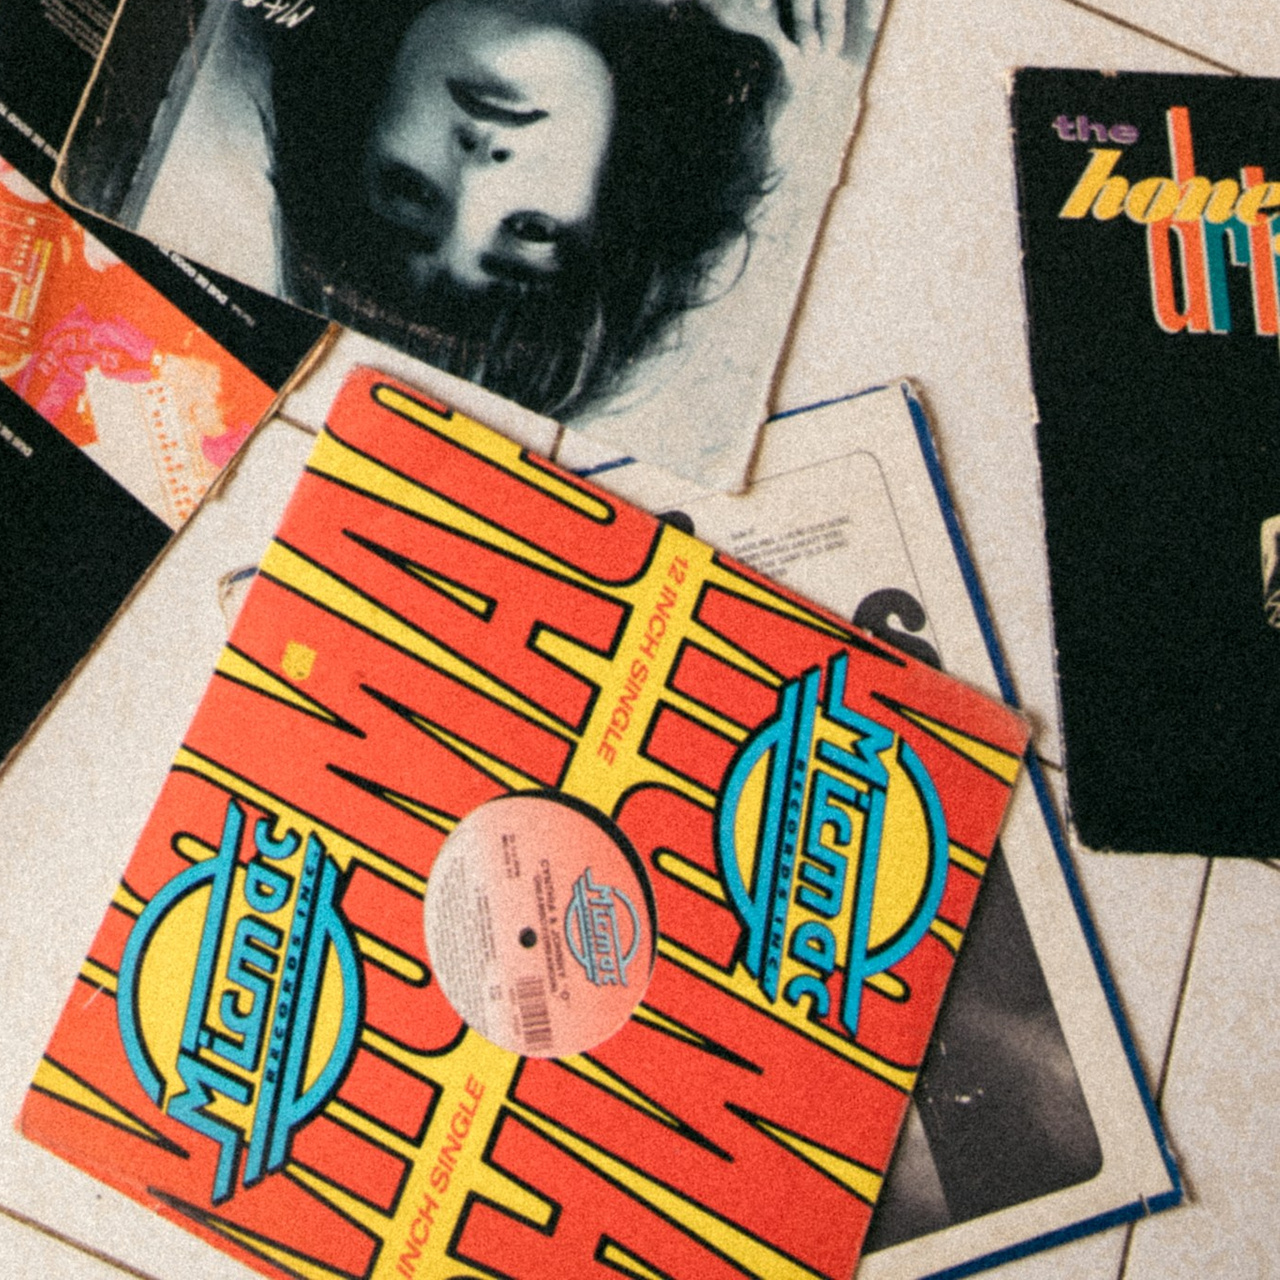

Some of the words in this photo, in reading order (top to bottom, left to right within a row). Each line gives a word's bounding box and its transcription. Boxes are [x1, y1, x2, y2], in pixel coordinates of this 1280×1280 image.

[1051, 114, 1141, 145] the
[638, 584, 678, 660] INCH
[667, 554, 689, 587] 12
[596, 658, 650, 767] SINGLE
[776, 755, 807, 904] RECORDS
[782, 650, 898, 1022] Micmac
[165, 816, 302, 1206] Micmac
[266, 936, 302, 1086] RECORDS
[395, 1192, 441, 1280] INCH
[429, 1073, 486, 1195] SINGLE
